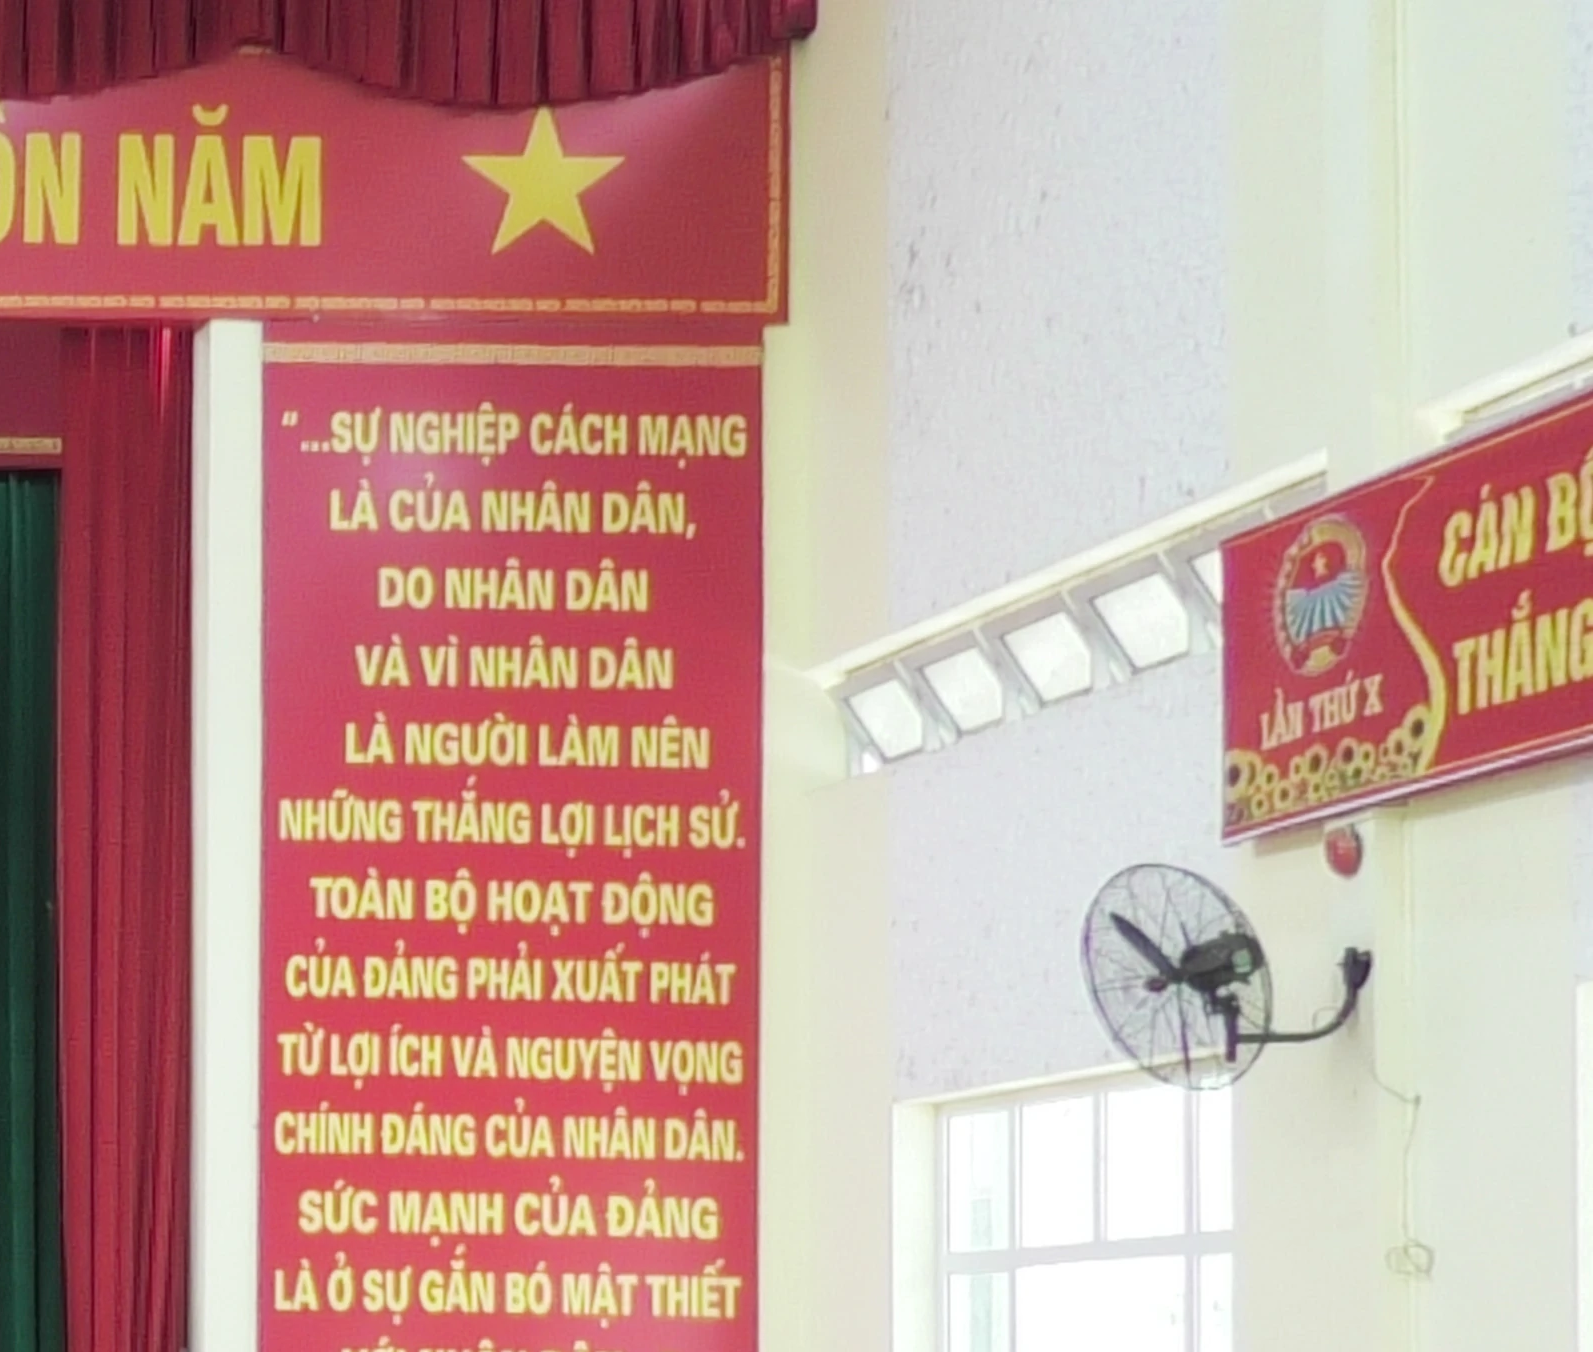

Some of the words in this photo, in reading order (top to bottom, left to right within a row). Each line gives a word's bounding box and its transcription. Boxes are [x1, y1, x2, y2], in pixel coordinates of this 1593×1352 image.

[117, 105, 322, 246] NĂM
[389, 402, 520, 465] NGHIỆP
[530, 404, 628, 455] CÁCH
[639, 415, 747, 468] MẠNG
[330, 479, 378, 530] LÀ
[389, 471, 470, 532] CỦA
[482, 481, 591, 532] NHÂN
[603, 481, 695, 538] DÂN,
[1438, 484, 1535, 587] CÁN
[1453, 589, 1593, 715] THẮNG
[1260, 688, 1302, 750] LẦN
[1309, 670, 1358, 734] THỨ
[1364, 674, 1384, 716] X
[279, 789, 403, 842] NHỮNG
[412, 776, 531, 844] THẮNG
[541, 802, 595, 857] LỢI
[604, 805, 680, 857] LỊCH
[689, 790, 745, 848] SỬ.
[310, 868, 414, 919] TOÀN
[425, 868, 477, 934] BỘ
[488, 880, 593, 936] HOẠT
[602, 872, 714, 937] ĐỘNG
[278, 1022, 324, 1076] TỪ
[330, 1032, 381, 1089] LỢI
[389, 1024, 443, 1077] ÍCH
[451, 1027, 498, 1078] VÀ
[506, 1028, 642, 1092] NGUYỆN
[650, 1040, 743, 1095] VỌNG
[275, 1259, 319, 1311] LÀ
[327, 1252, 354, 1311] Ở
[363, 1266, 412, 1324] SỰ
[419, 1242, 495, 1313] GẮN
[505, 1262, 553, 1315] BÓ
[562, 1263, 638, 1328] MẬT
[645, 1259, 741, 1318] THIẾT
